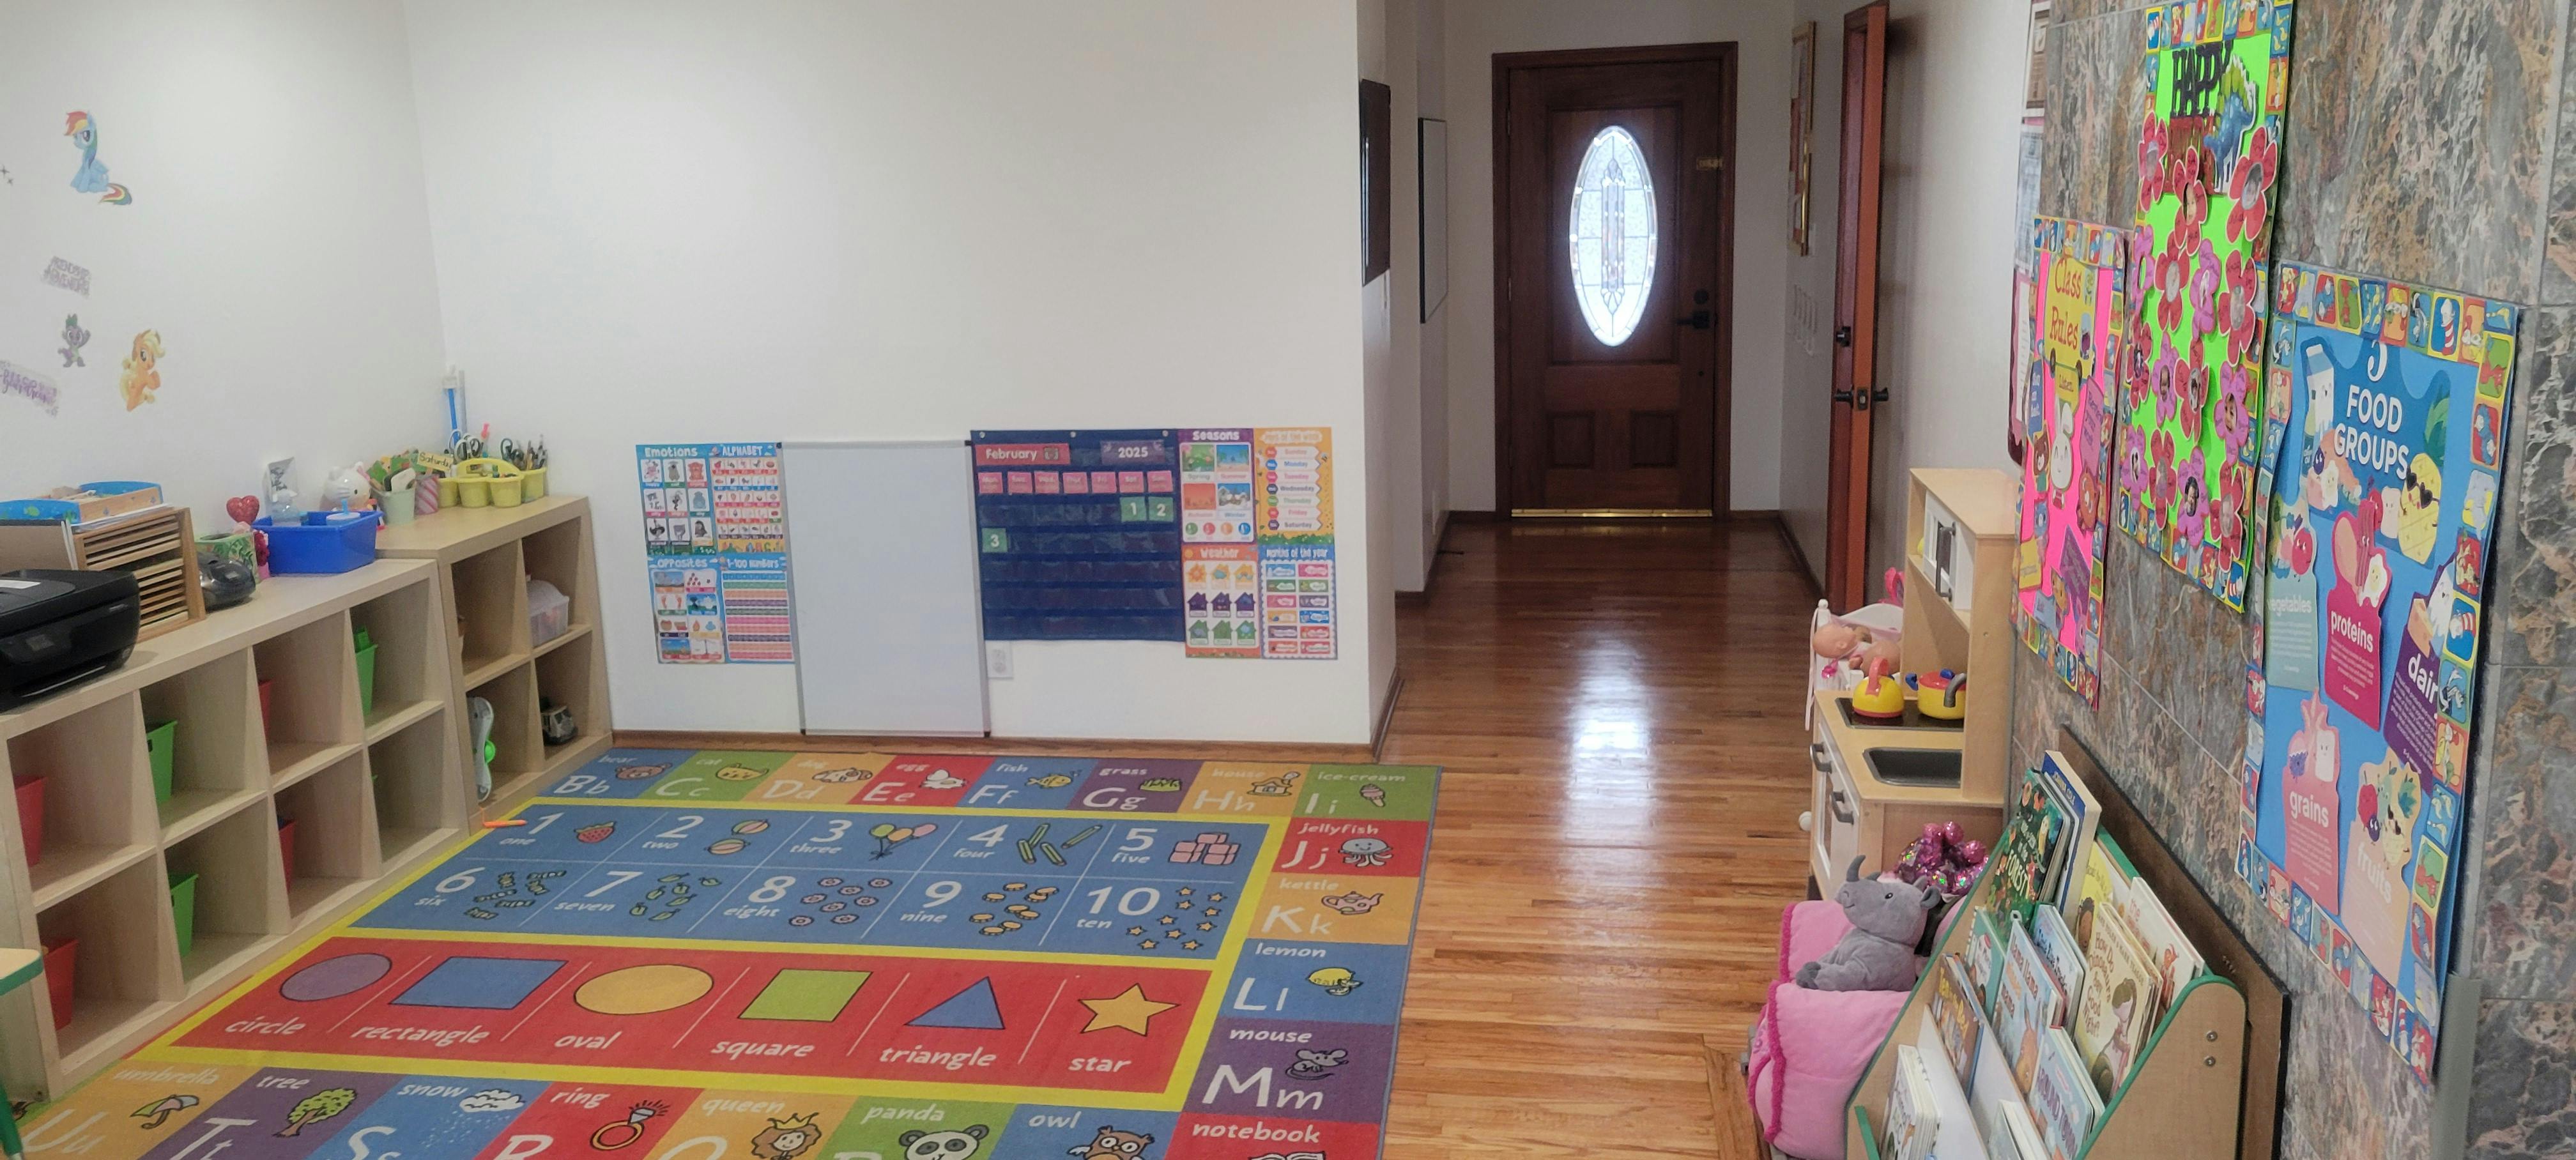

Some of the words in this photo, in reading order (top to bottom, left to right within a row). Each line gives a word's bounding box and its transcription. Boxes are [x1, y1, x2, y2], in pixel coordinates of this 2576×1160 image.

[2170, 40, 2234, 118] HAPPY
[2055, 258, 2082, 300] Class
[2050, 305, 2079, 350] Rules
[2346, 384, 2402, 433] FOOD
[1192, 431, 1239, 441] Seasons
[645, 447, 698, 457] Emotions
[723, 445, 763, 456] ALPHABET
[986, 448, 1037, 461] February
[1119, 447, 1148, 458] 2025
[2333, 423, 2410, 480] GROUPS
[1130, 502, 1137, 515] 1
[1157, 503, 1166, 516] 2
[990, 535, 999, 547] 3
[2331, 610, 2373, 653] proteins
[2408, 653, 2438, 719] dair
[599, 755, 638, 765] bear
[695, 756, 723, 767] cat
[896, 763, 930, 773] egg
[995, 763, 1028, 773] fish
[1098, 767, 1147, 776] grass
[1212, 769, 1268, 779] house
[1317, 771, 1407, 783] ice-cream
[2289, 790, 2329, 828] grains
[528, 812, 565, 835] 1
[656, 814, 705, 839] 2
[809, 820, 852, 843] 3
[1298, 821, 1379, 836] jellyfish
[499, 836, 536, 846] one
[641, 840, 679, 850] two
[967, 824, 1009, 848] 4
[1119, 828, 1158, 851] 5
[789, 843, 843, 855] three
[953, 848, 995, 860] four
[1111, 852, 1152, 865] five
[434, 867, 486, 893] 6
[2006, 849, 2028, 897] FOREST
[2356, 841, 2393, 905] fruits
[585, 871, 644, 897] 7
[747, 876, 797, 904] 8
[1279, 878, 1340, 891] kettle
[414, 894, 447, 907] six
[923, 880, 963, 909] 9
[1086, 886, 1162, 917] 10
[553, 901, 617, 912] seven
[723, 903, 779, 919] eight
[899, 910, 947, 924] nine
[1077, 918, 1113, 929] ten
[1255, 942, 1326, 958] lemon
[224, 1017, 308, 1036] circle
[351, 1023, 491, 1048] rectangle
[1229, 1028, 1313, 1044] mouse
[553, 1031, 623, 1051] oval
[710, 1037, 816, 1060] square
[879, 1045, 999, 1071] triangle
[1068, 1054, 1133, 1074] star
[113, 1067, 222, 1086] umbrella
[257, 1073, 311, 1090] tree
[396, 1082, 468, 1099] snow
[549, 1087, 611, 1110] ring
[702, 1098, 786, 1117] queen
[862, 1103, 946, 1126] panda
[1027, 1111, 1082, 1132] owl
[1192, 1121, 1320, 1143] notebook
